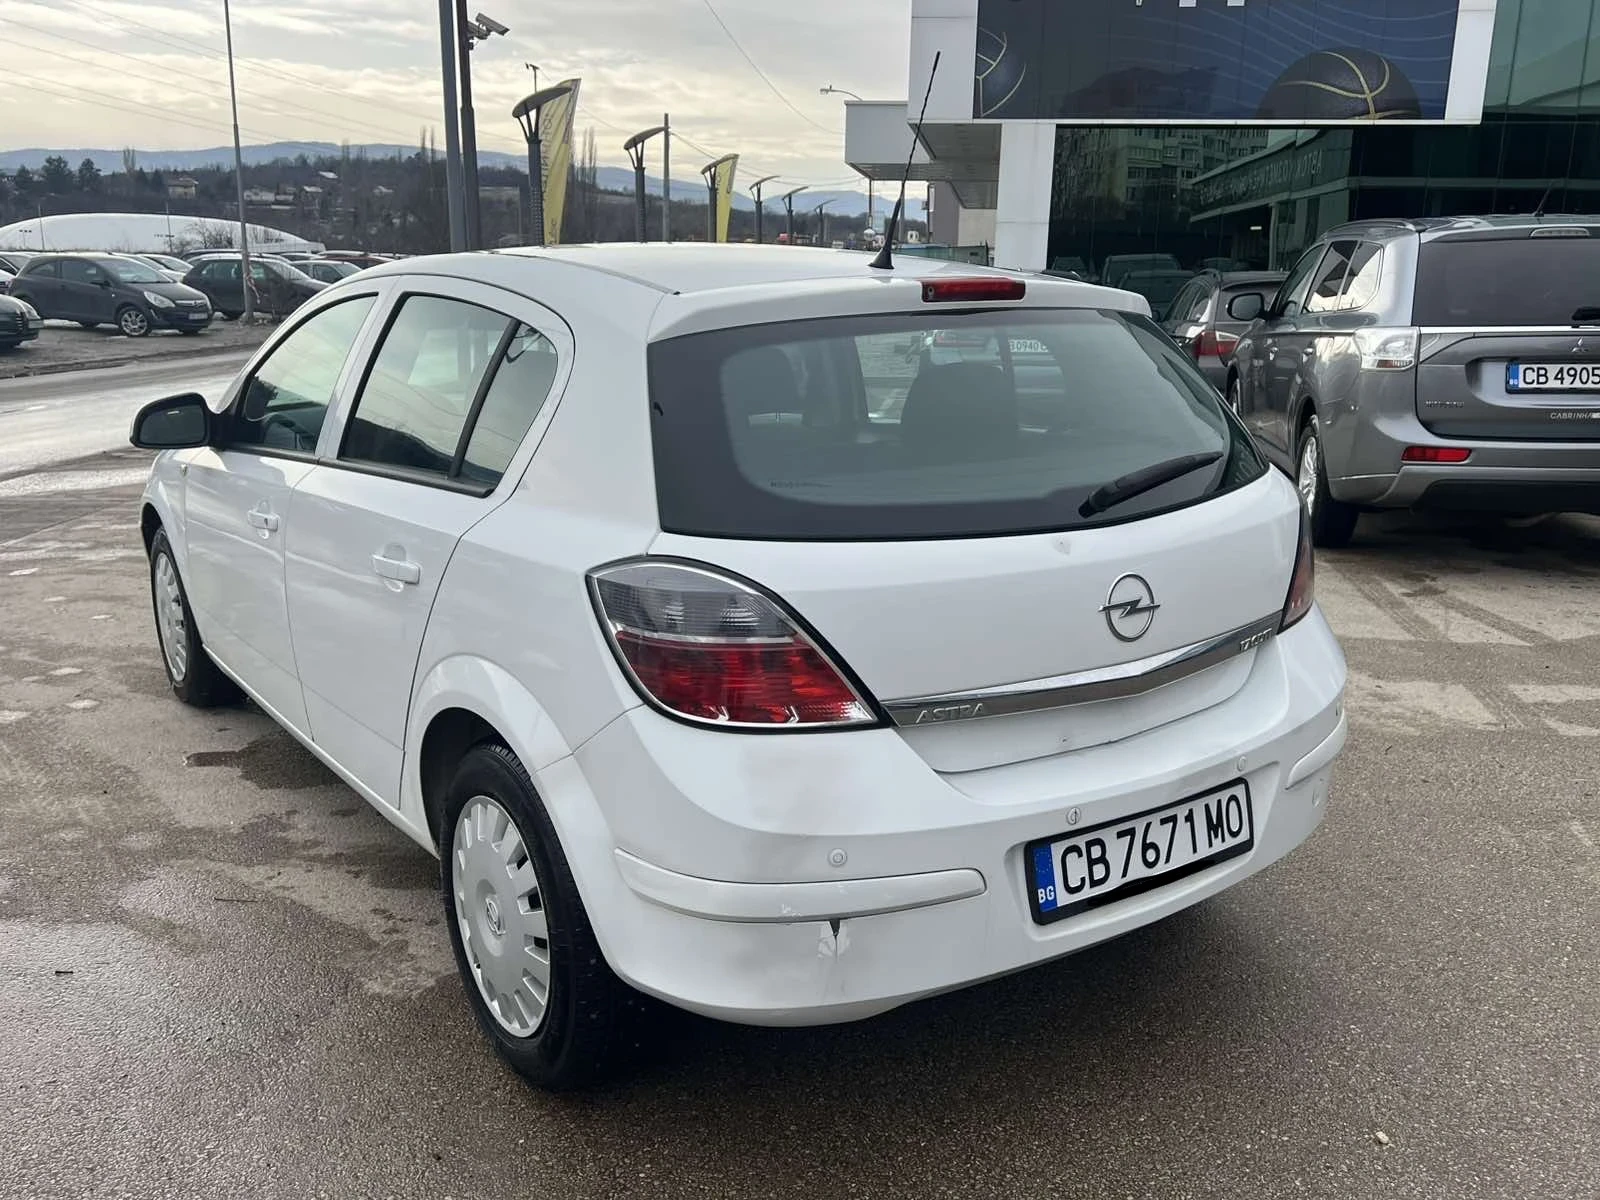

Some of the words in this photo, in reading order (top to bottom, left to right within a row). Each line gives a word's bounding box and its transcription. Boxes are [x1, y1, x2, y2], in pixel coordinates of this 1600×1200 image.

[1523, 367, 1548, 385] CB
[1554, 367, 1600, 385] 4905
[915, 702, 985, 724] ASTRA
[1060, 837, 1111, 895] CB
[1116, 806, 1198, 879] 7671
[1204, 794, 1244, 848] MO
[1037, 885, 1055, 904] BG
